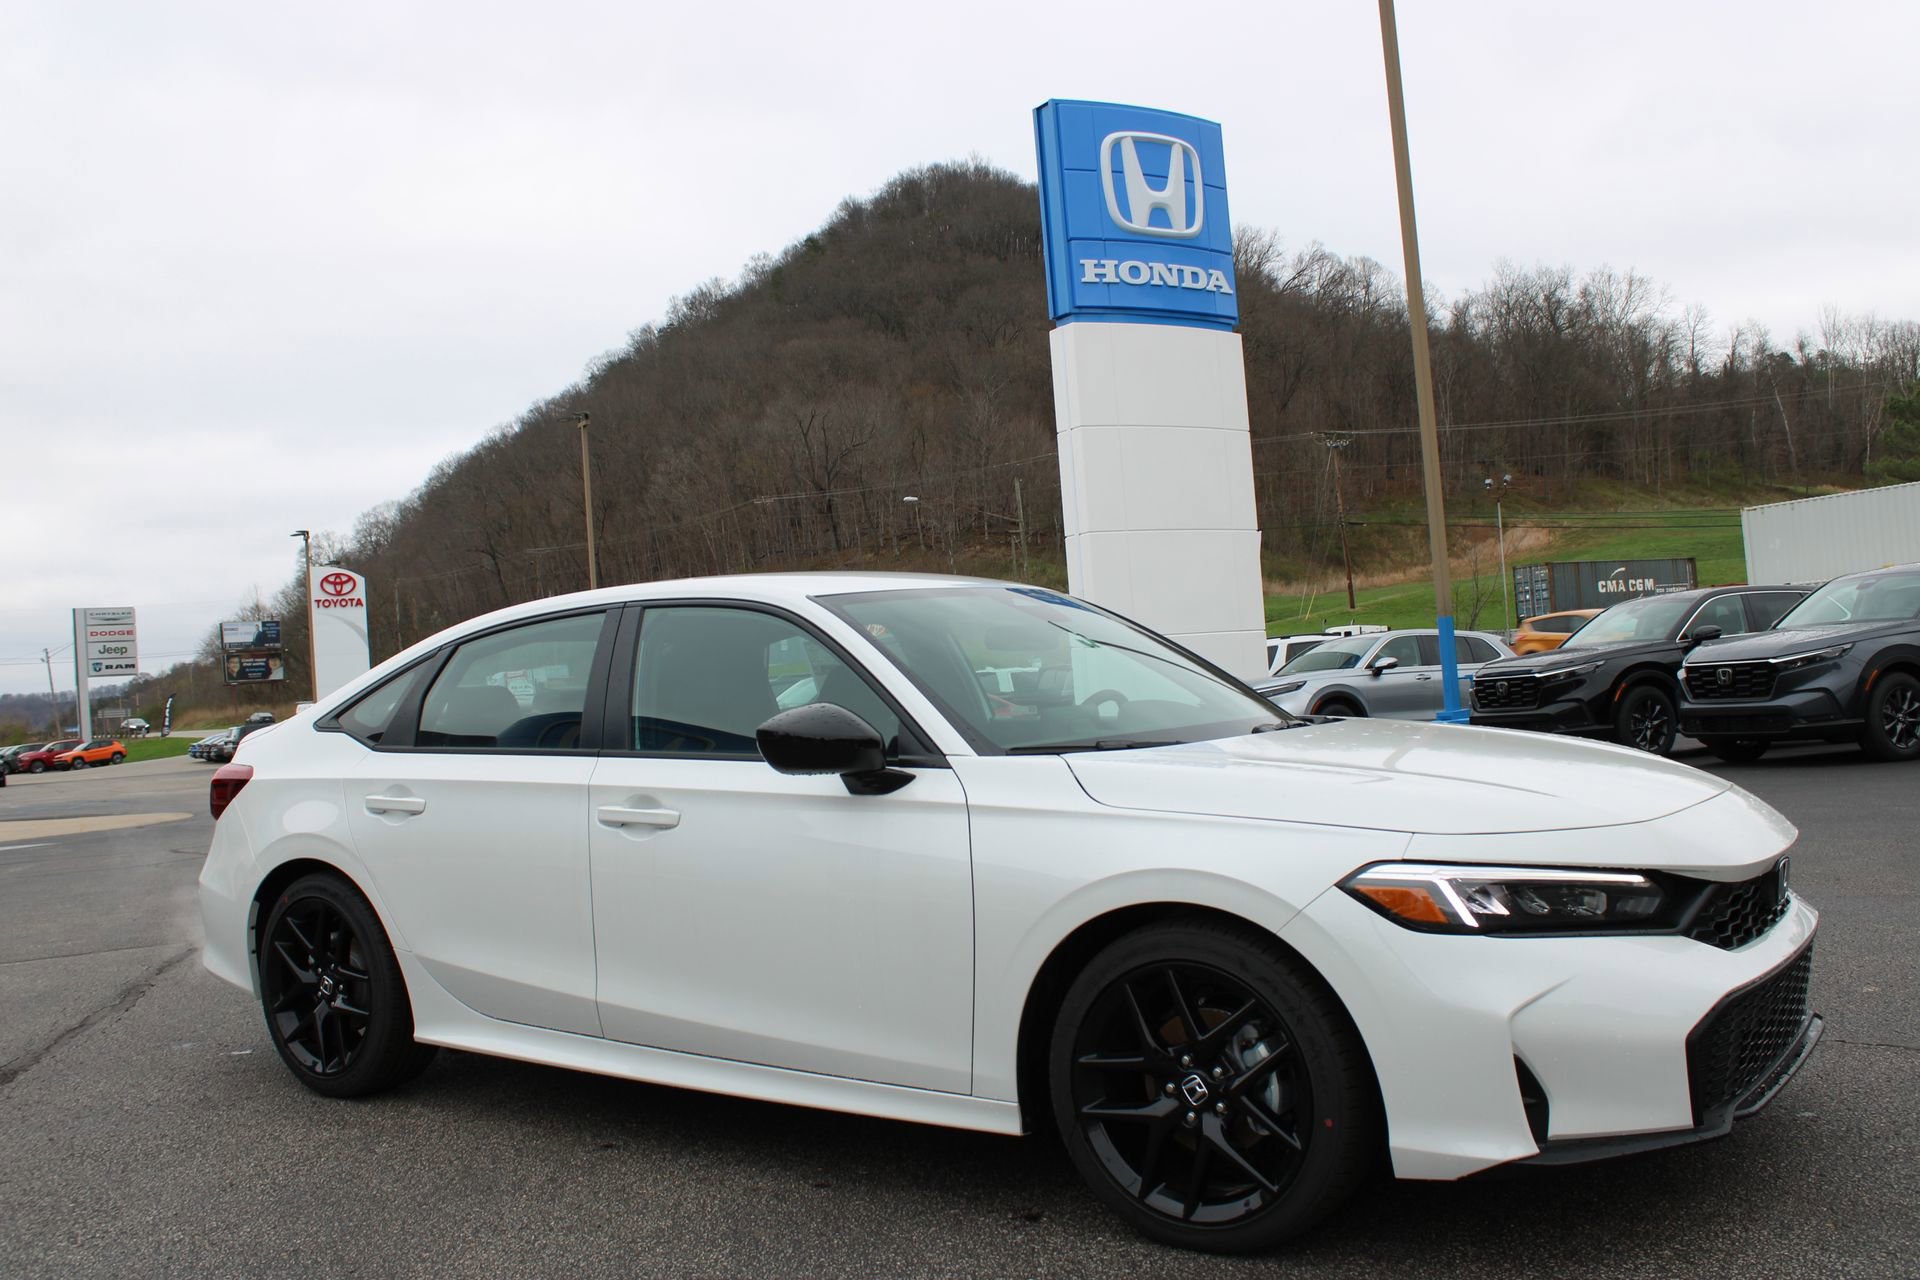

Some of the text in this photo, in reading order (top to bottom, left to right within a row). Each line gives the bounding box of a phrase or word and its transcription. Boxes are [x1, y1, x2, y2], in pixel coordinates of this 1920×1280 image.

[1079, 258, 1234, 295] HONDA
[1597, 580, 1626, 593] CMA
[1628, 578, 1655, 592] CGM
[314, 598, 364, 609] TOYOTA
[90, 629, 134, 637] DODGE
[98, 644, 128, 656] Jeep
